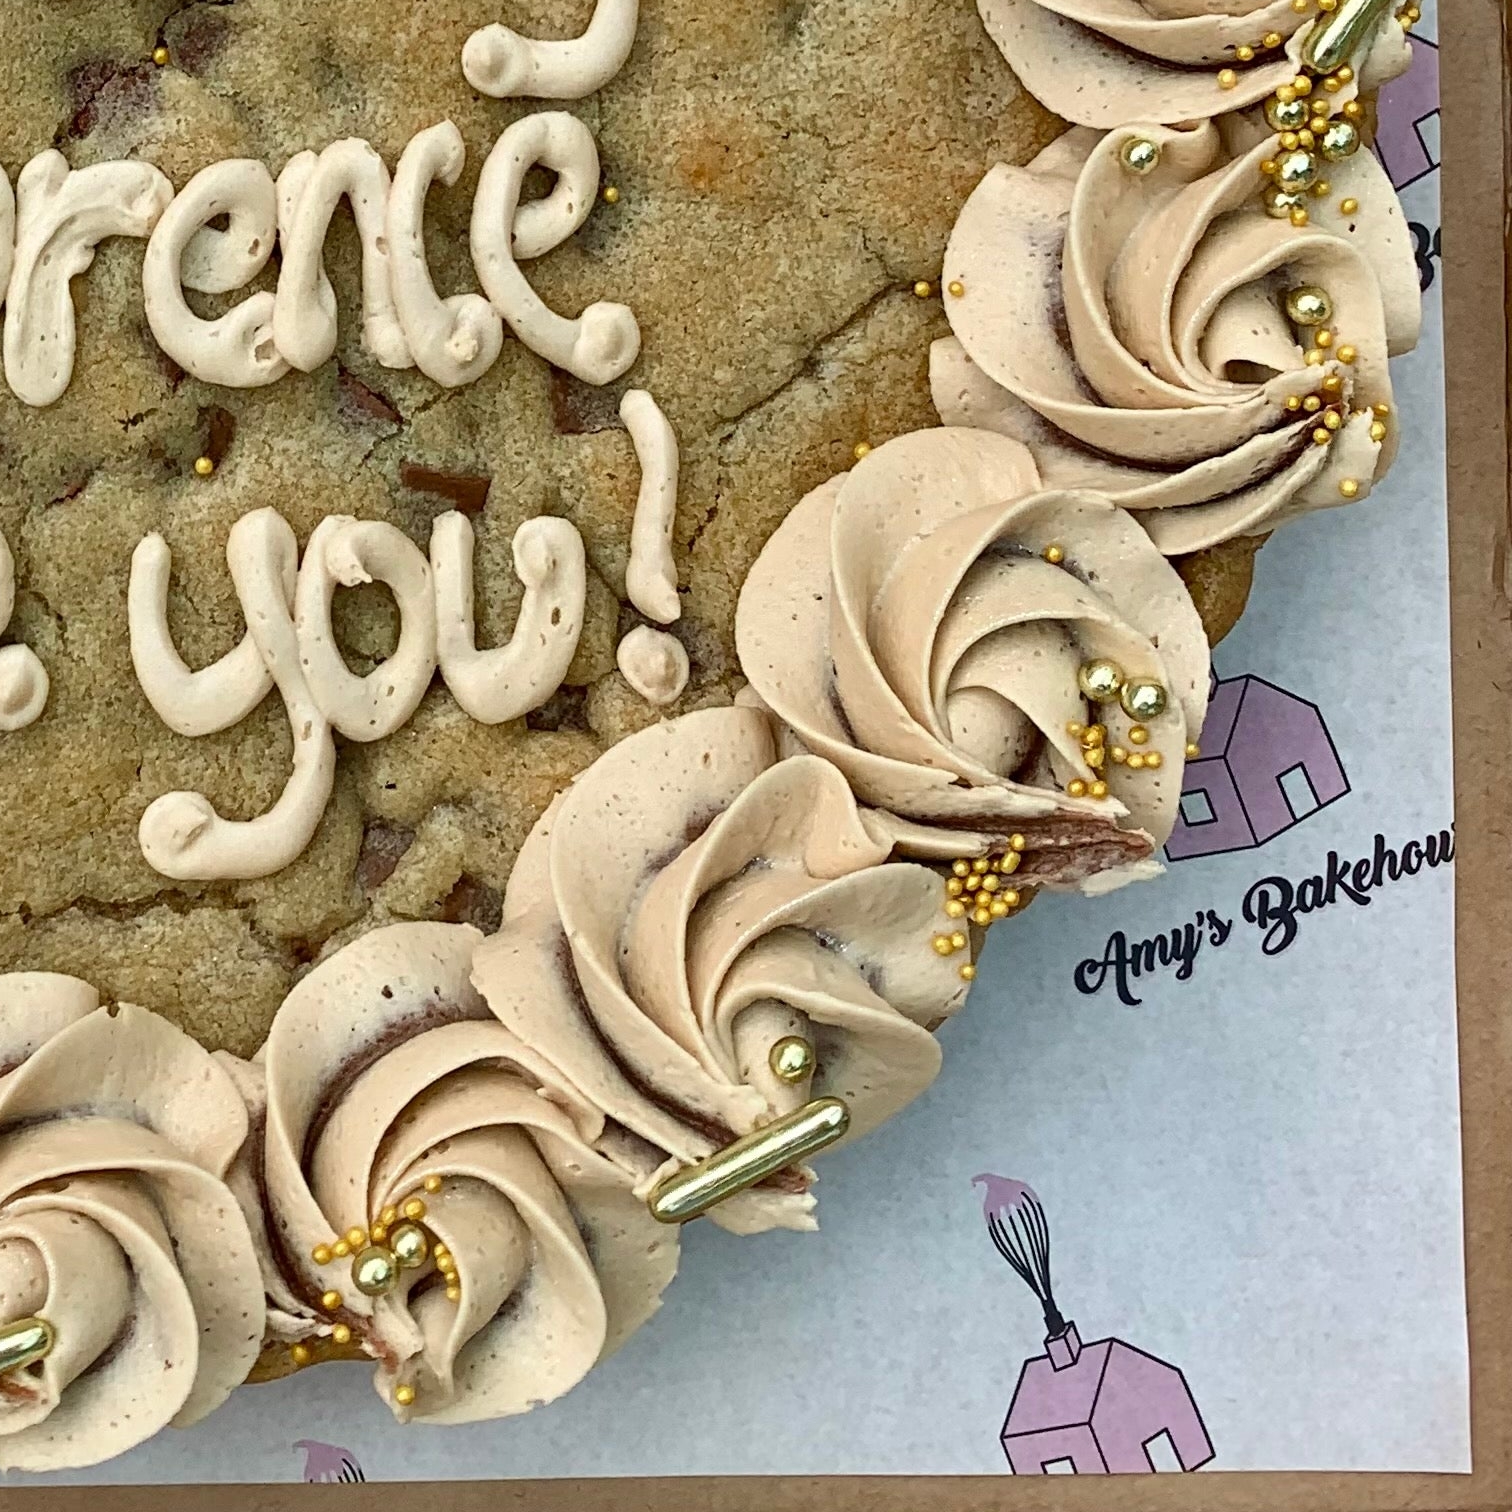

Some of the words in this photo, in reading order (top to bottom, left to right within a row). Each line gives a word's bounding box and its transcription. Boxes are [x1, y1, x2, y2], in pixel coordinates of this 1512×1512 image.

[128, 388, 689, 881] you!
[1074, 910, 1232, 1005] Amy's
[1241, 822, 1455, 955] Bakehou
